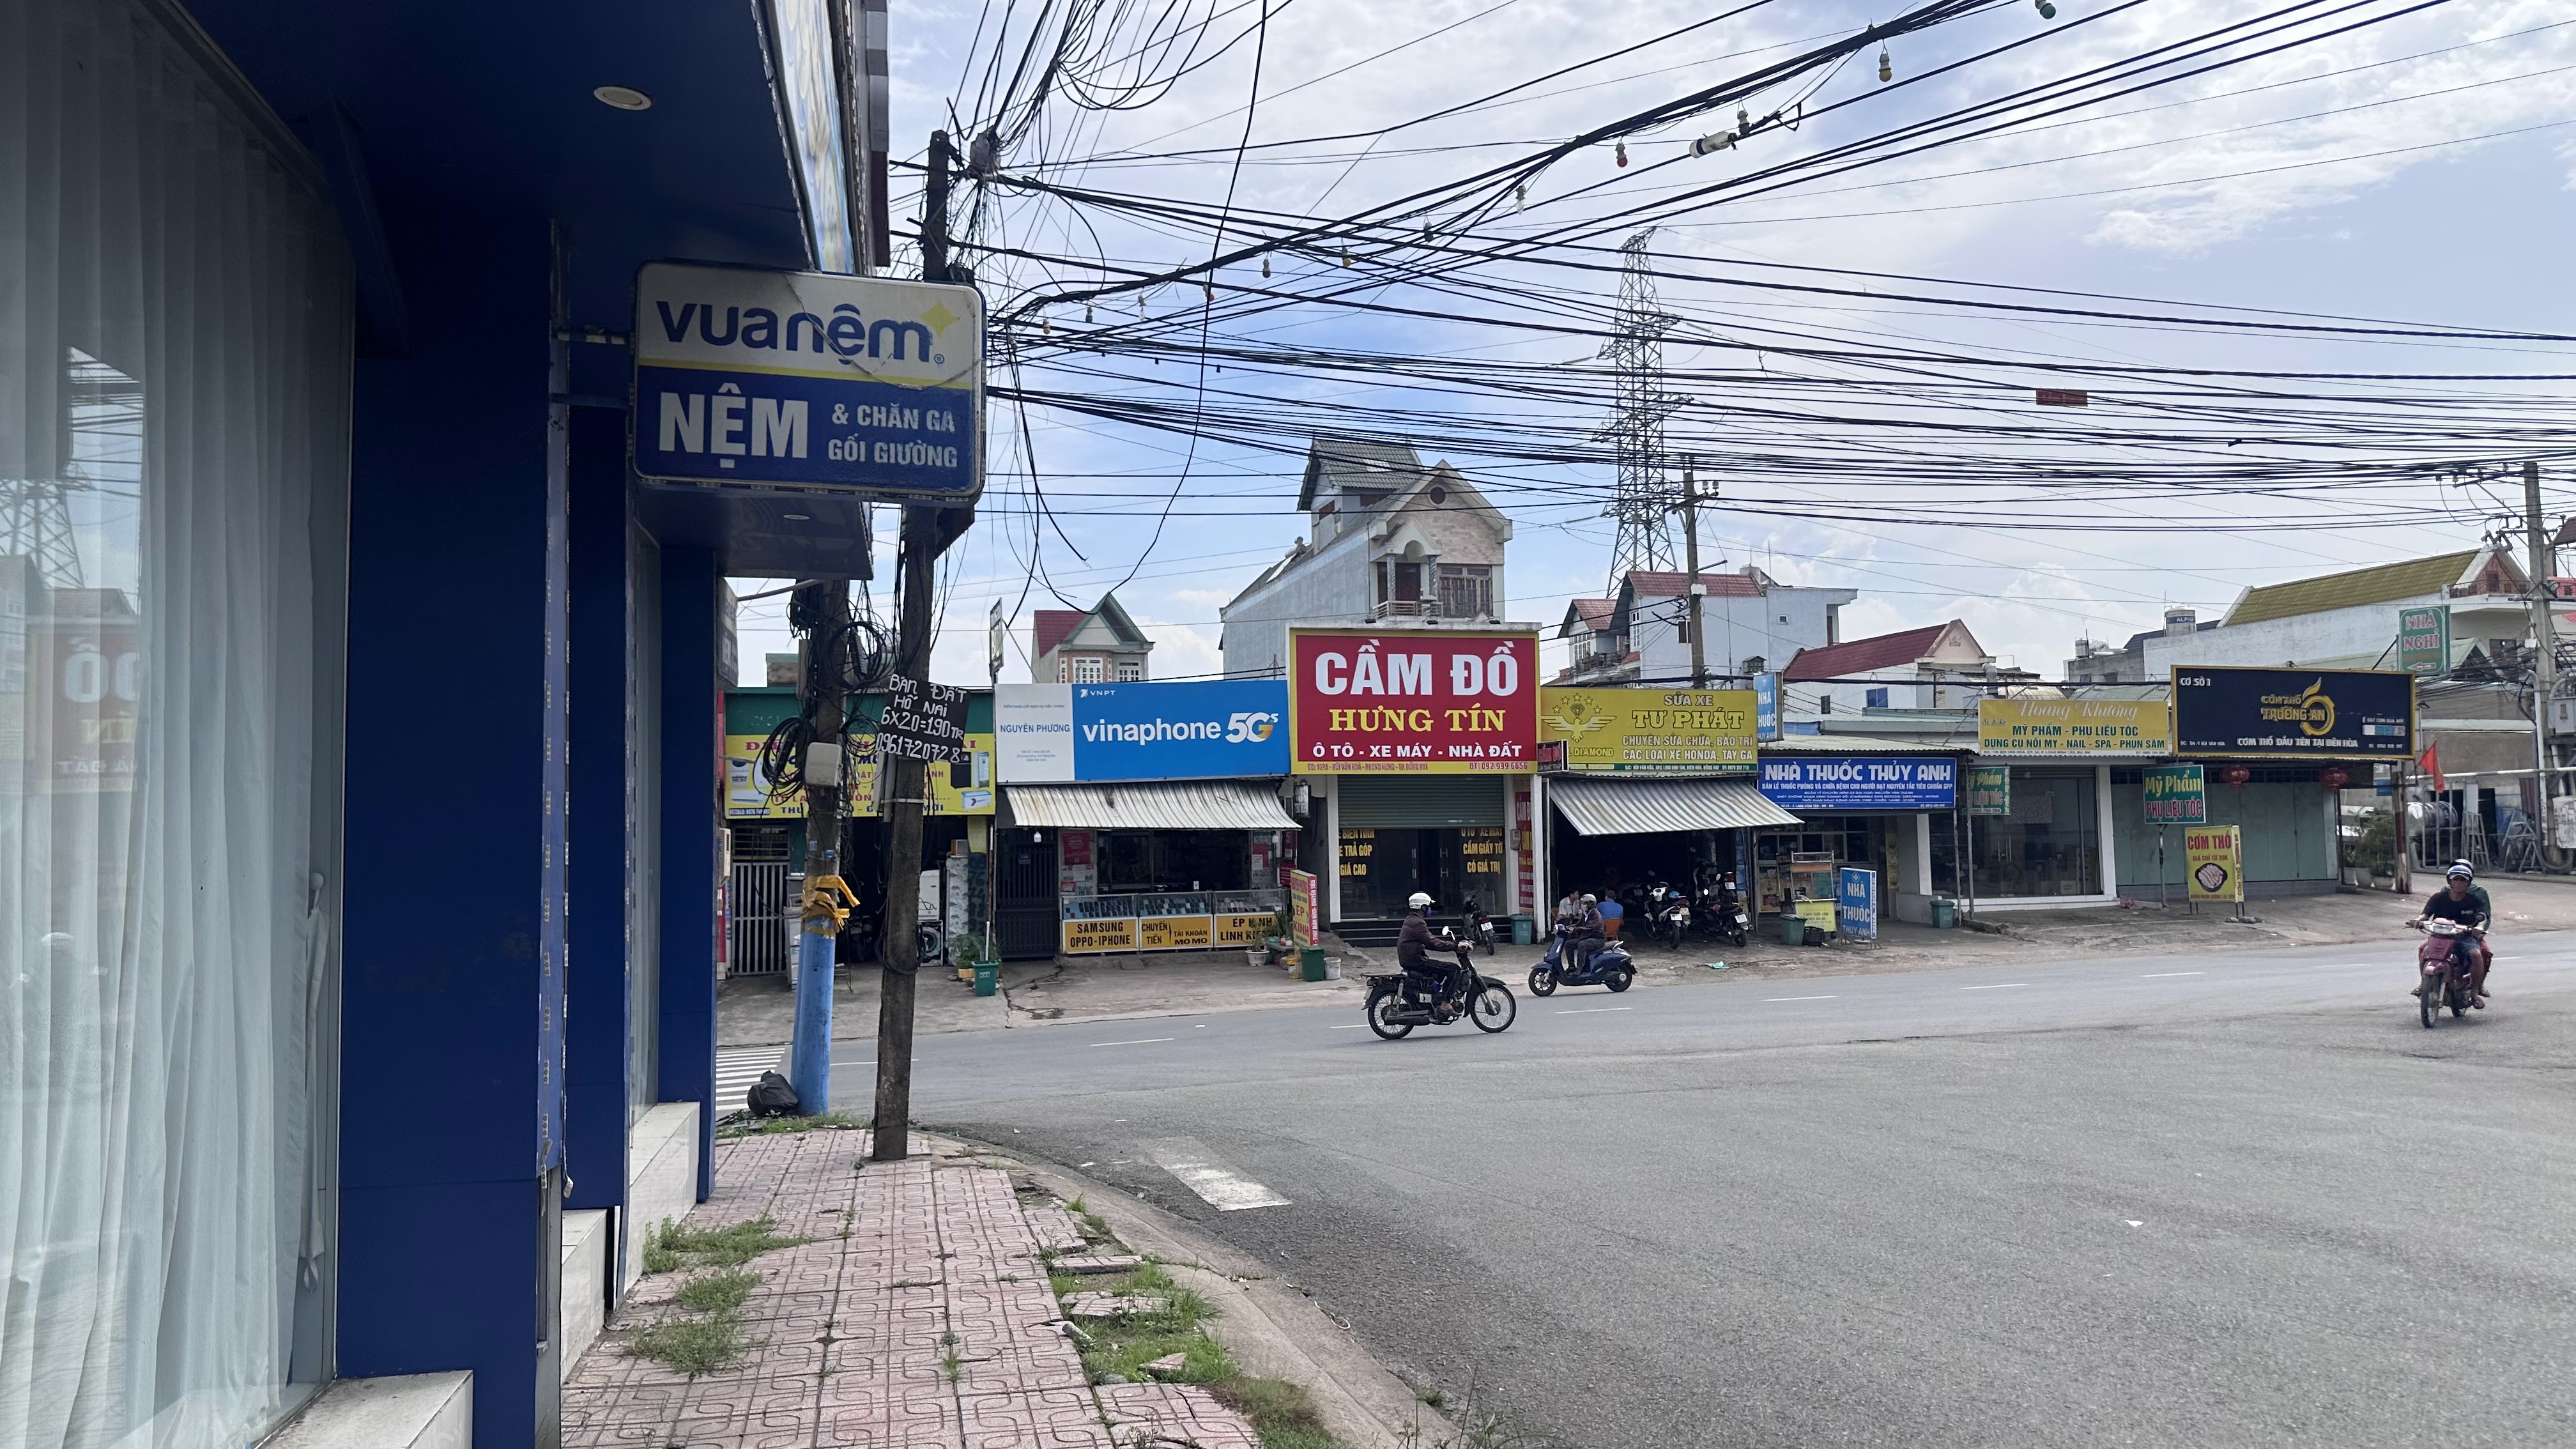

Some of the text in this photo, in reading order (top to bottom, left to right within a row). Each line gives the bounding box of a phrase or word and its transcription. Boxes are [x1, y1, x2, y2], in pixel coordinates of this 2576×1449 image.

[659, 383, 808, 469] NỆM
[832, 402, 955, 433] & CHĂN GA
[828, 433, 958, 468] GỐI GIƯỜNG
[2405, 610, 2437, 630] NHÀ
[2403, 628, 2440, 650] NGHỈ
[1315, 639, 1518, 696] CẦM ĐỒ
[2179, 677, 2191, 686] CƠ
[2193, 676, 2205, 686] SỞ
[930, 683, 967, 703] ĐẤT
[1664, 691, 1713, 706] SỬA XE
[1330, 703, 1506, 732] HƯNG TÍN
[1632, 707, 1744, 729] TƯ PHÁT
[2013, 701, 2070, 721] Hoàng
[1000, 723, 1070, 733] NGUYÊN PHƯƠNG
[1082, 718, 1221, 746] vinaphone
[2012, 722, 2138, 739] MỸ PHẨM PHỤ LIỆU TÓC
[1313, 740, 1522, 757] Ô TÔ XE MÁY NHÀ ĐẤT
[1622, 732, 1753, 747] CHUYÊN SỬA CHỮA, BẢO TRÌ
[1984, 739, 2009, 749] DỤNG
[2012, 739, 2023, 749] CỤ
[2027, 737, 2041, 747] NỐI
[2067, 740, 2086, 748] NAIL
[2095, 740, 2111, 748] SPA
[2120, 740, 2143, 748] PHUN
[1574, 747, 1614, 756] DIAMOND
[1623, 747, 1753, 762] CÁC LOẠI XE HONDA, TAY GA
[1765, 759, 1951, 781] NHÀ THUỐC THỦY ANH
[2145, 769, 2201, 797] Mỹ Phẩm
[2146, 795, 2202, 822] PHỤ LIỆU TÓC
[1478, 839, 1493, 854] GIẤY
[2188, 829, 2231, 850] CƠM THỐ
[1344, 841, 1358, 857] TRẢ
[1358, 842, 1373, 857] GÓP
[1340, 861, 1367, 876] GIÁ CAO
[1477, 859, 1489, 873] GIÁ
[1847, 881, 1866, 898] NHÀ
[1843, 903, 1870, 923] THUỐC
[1077, 921, 1123, 933] SAMSUNG
[1232, 917, 1245, 928] ÉP
